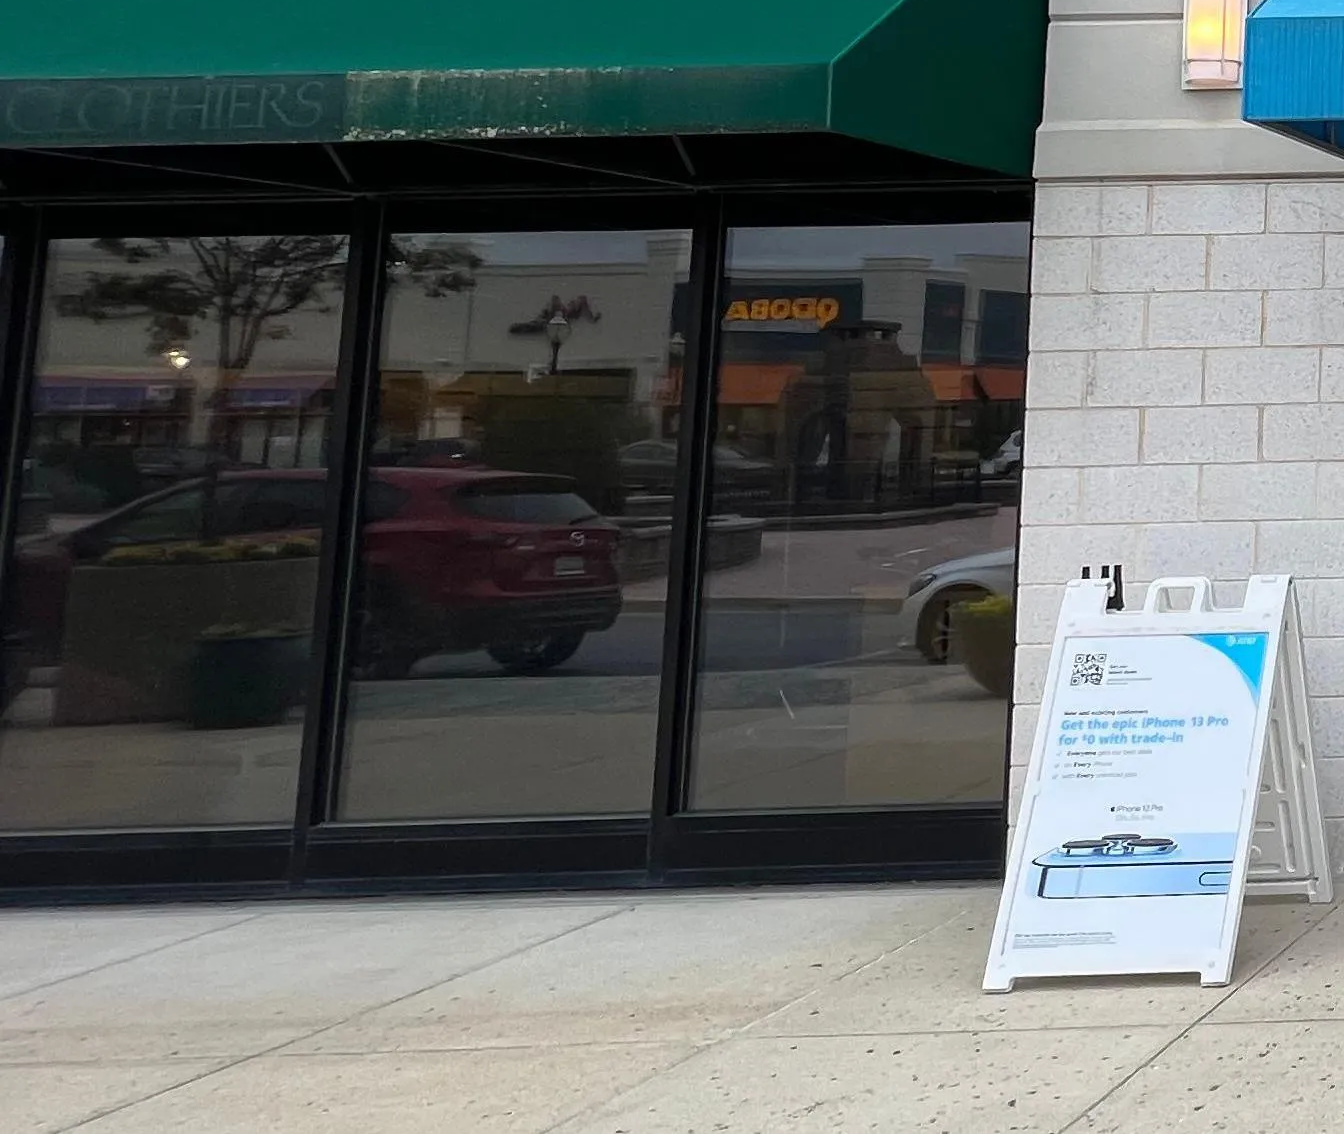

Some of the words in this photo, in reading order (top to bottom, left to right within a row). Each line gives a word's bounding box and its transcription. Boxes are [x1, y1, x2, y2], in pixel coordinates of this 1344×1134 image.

[1061, 719, 1084, 731] Get
[1087, 718, 1109, 730] the
[1111, 717, 1138, 732] epic
[1142, 716, 1186, 729] iPhone
[1191, 717, 1204, 727] 13
[1206, 716, 1229, 726] Pro
[1058, 734, 1078, 746] for
[1099, 733, 1128, 745] with
[1131, 732, 1184, 744] trade-in
